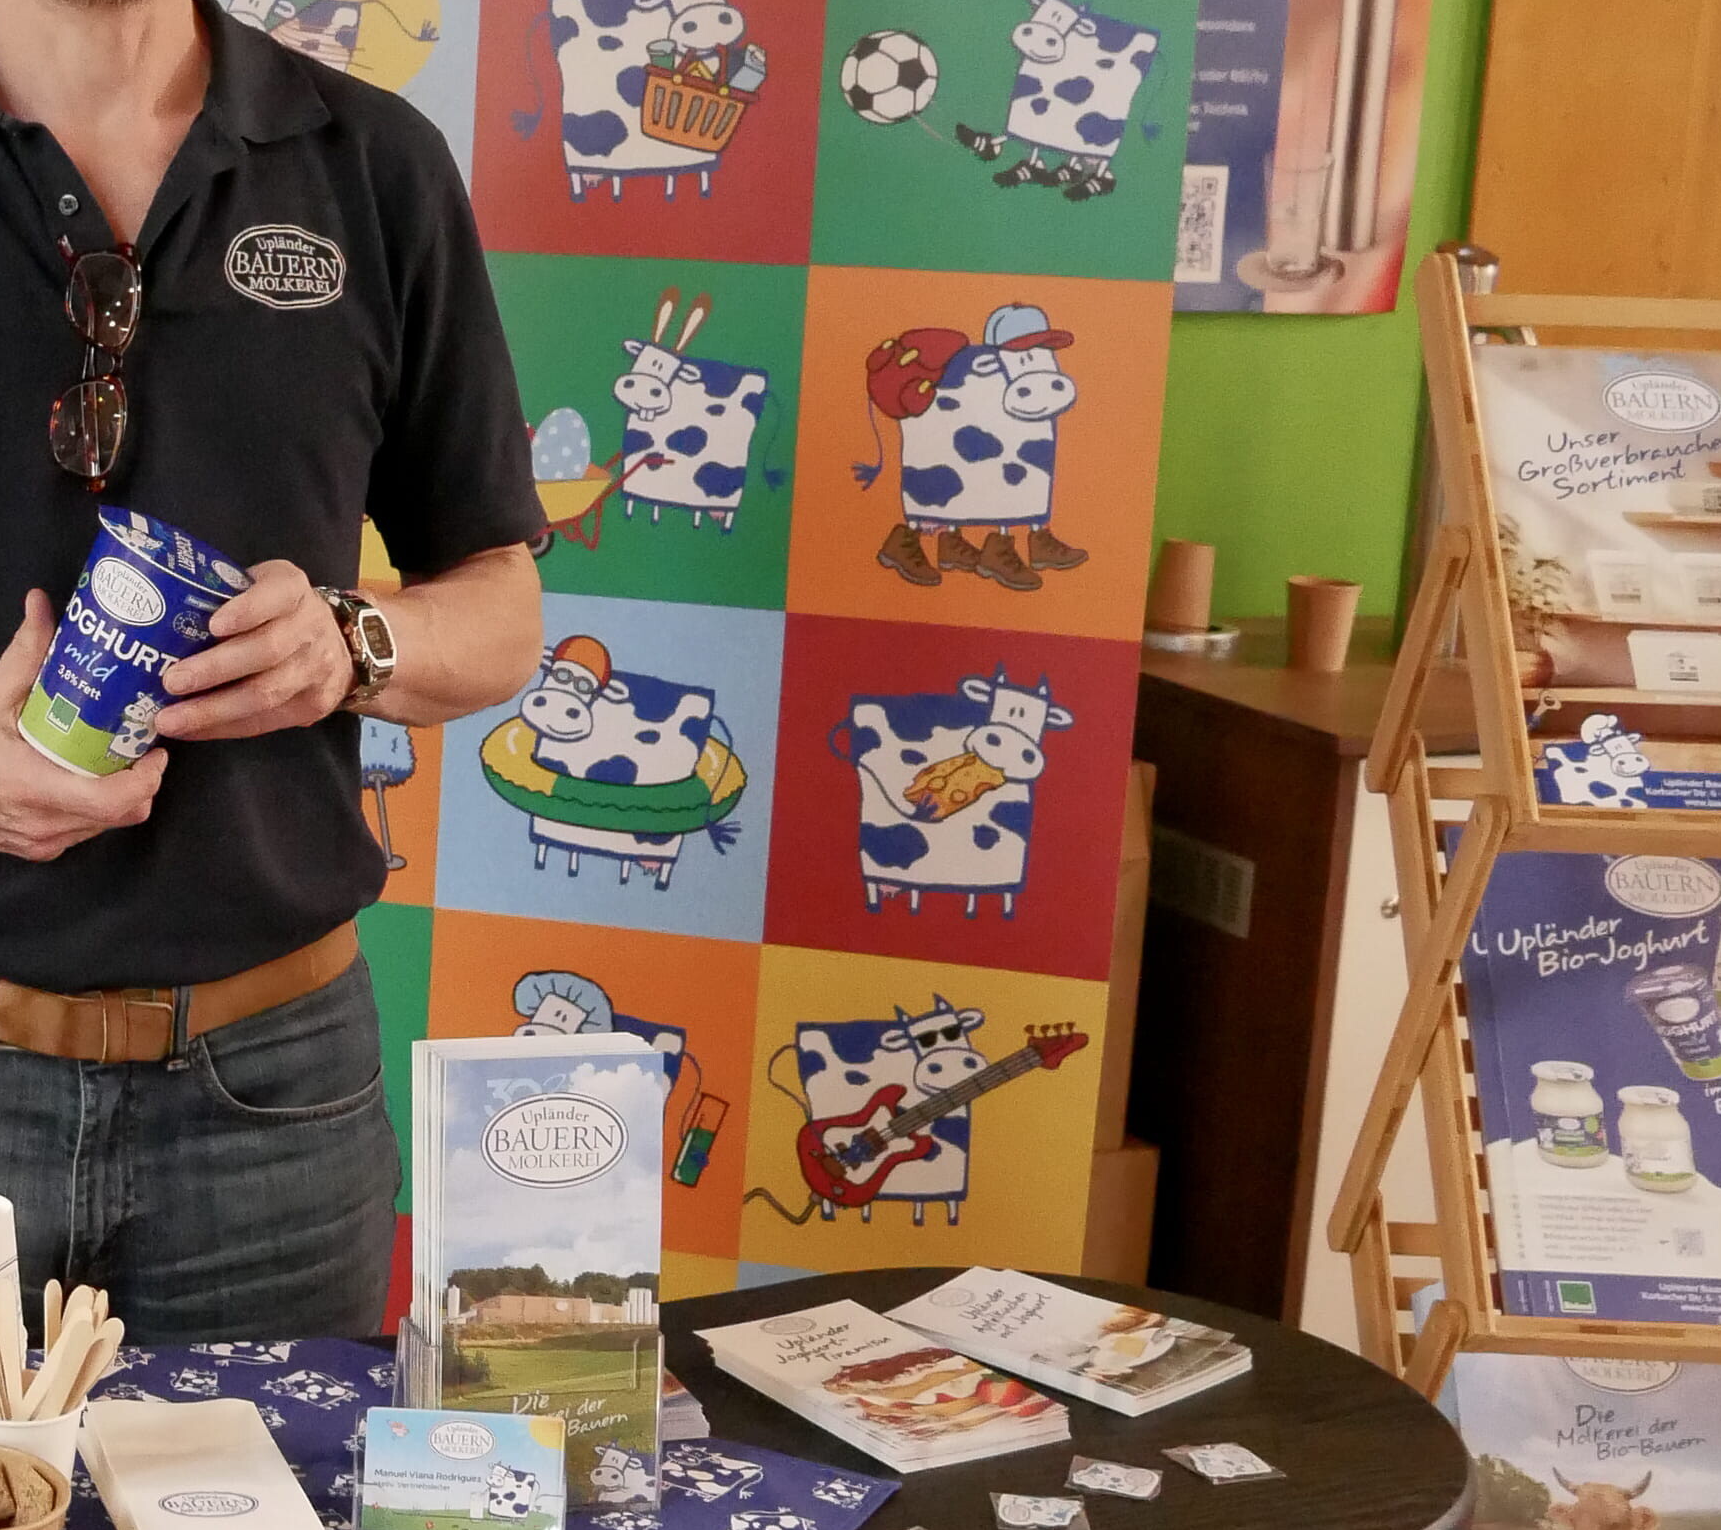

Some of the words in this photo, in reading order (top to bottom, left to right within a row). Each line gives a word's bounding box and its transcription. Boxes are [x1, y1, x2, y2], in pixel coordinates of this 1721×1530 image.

[256, 236, 315, 255] Upländer
[235, 251, 339, 281] BAUERN
[249, 277, 330, 294] MOLKEREI
[1611, 390, 1713, 409] BAUERN
[1547, 431, 1620, 453] Unser
[1553, 458, 1686, 500] Sortiment
[96, 564, 159, 616] BAUERN
[64, 641, 118, 682] mild
[78, 679, 102, 701] Fett
[1614, 871, 1714, 893] BAUERN
[1498, 916, 1622, 960] Upländer
[1538, 920, 1709, 977] Bio-Joghurt
[522, 1106, 589, 1126] Upländer
[494, 1125, 615, 1152] BAUERN
[508, 1153, 600, 1169] MOLKEREI
[513, 1390, 549, 1414] Die
[577, 1398, 606, 1415] der
[1576, 1405, 1615, 1426] Die
[433, 1432, 490, 1447] BAUERN
[1557, 1425, 1640, 1448] Molkerei
[1649, 1419, 1678, 1435] der
[1597, 1438, 1706, 1460] Bio-Bauern
[374, 1468, 408, 1478] Manuel
